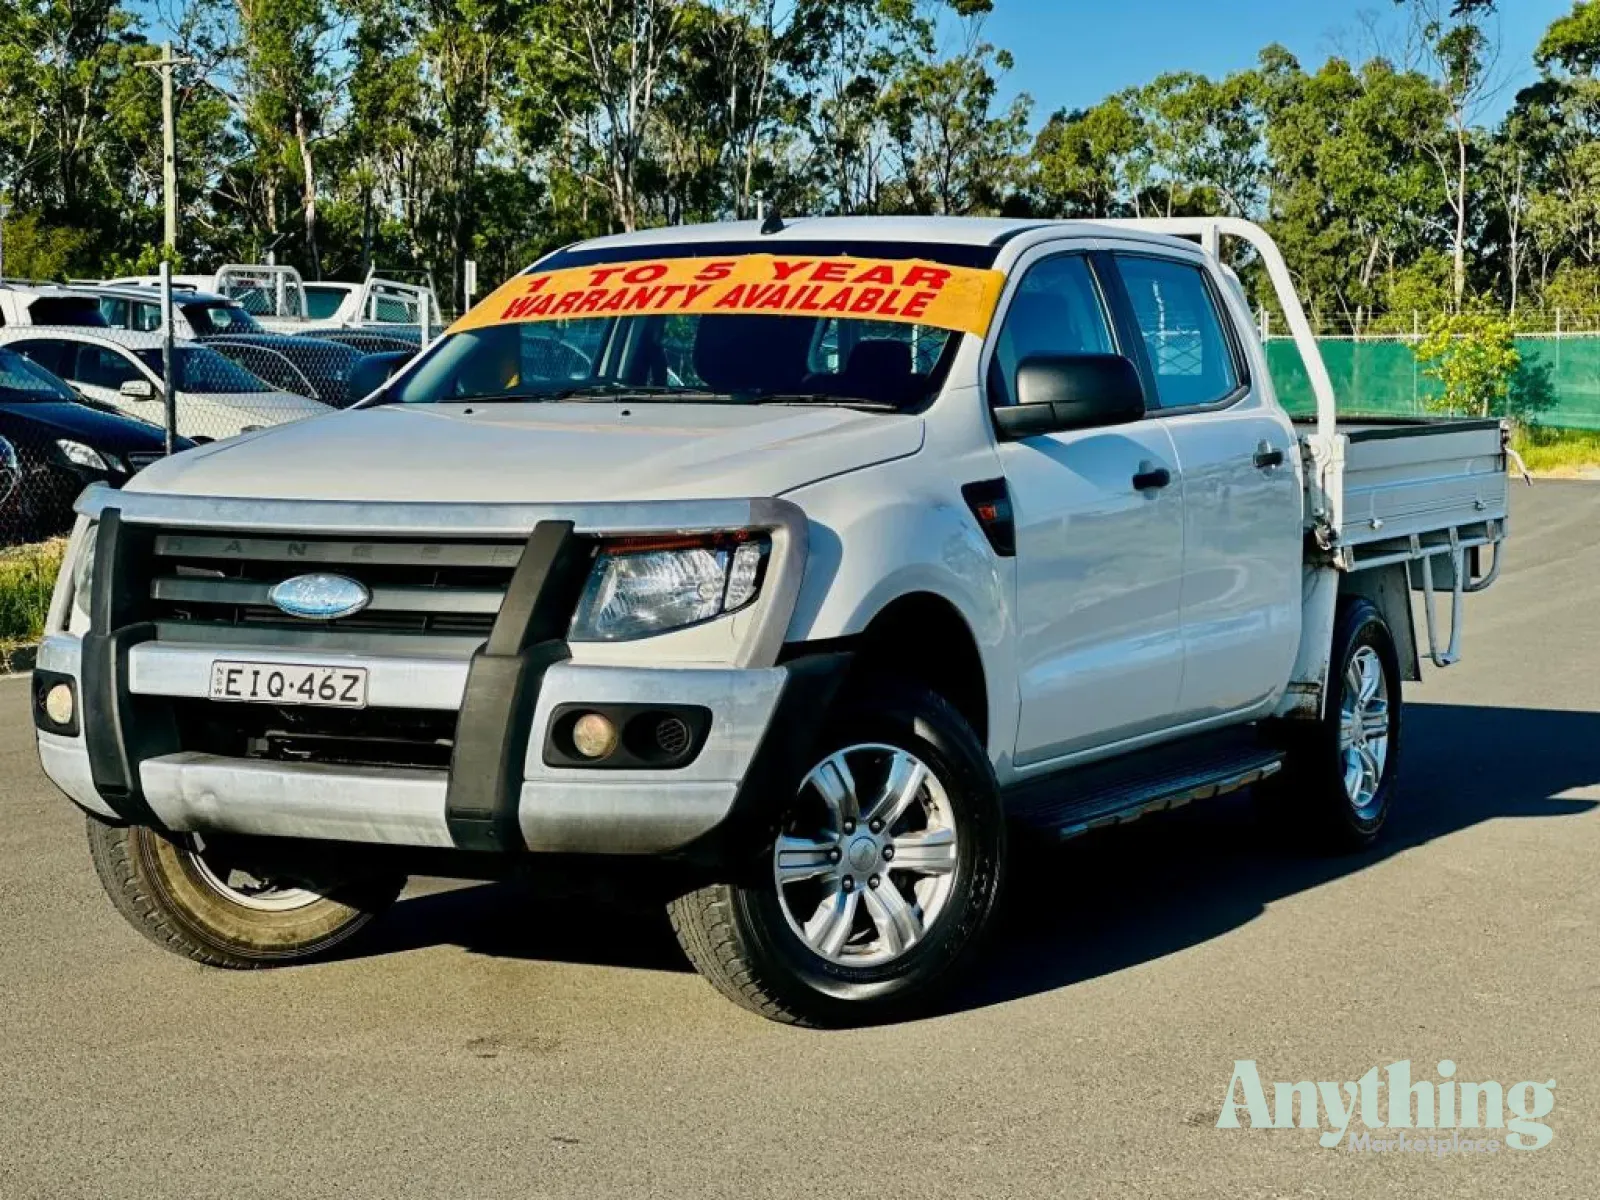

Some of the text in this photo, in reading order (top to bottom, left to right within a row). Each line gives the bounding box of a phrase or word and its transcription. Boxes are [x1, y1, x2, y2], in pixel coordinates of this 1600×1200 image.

[527, 261, 952, 293] 1 TO 5 YEAR
[501, 284, 937, 320] WARRANTY AVAILABLE
